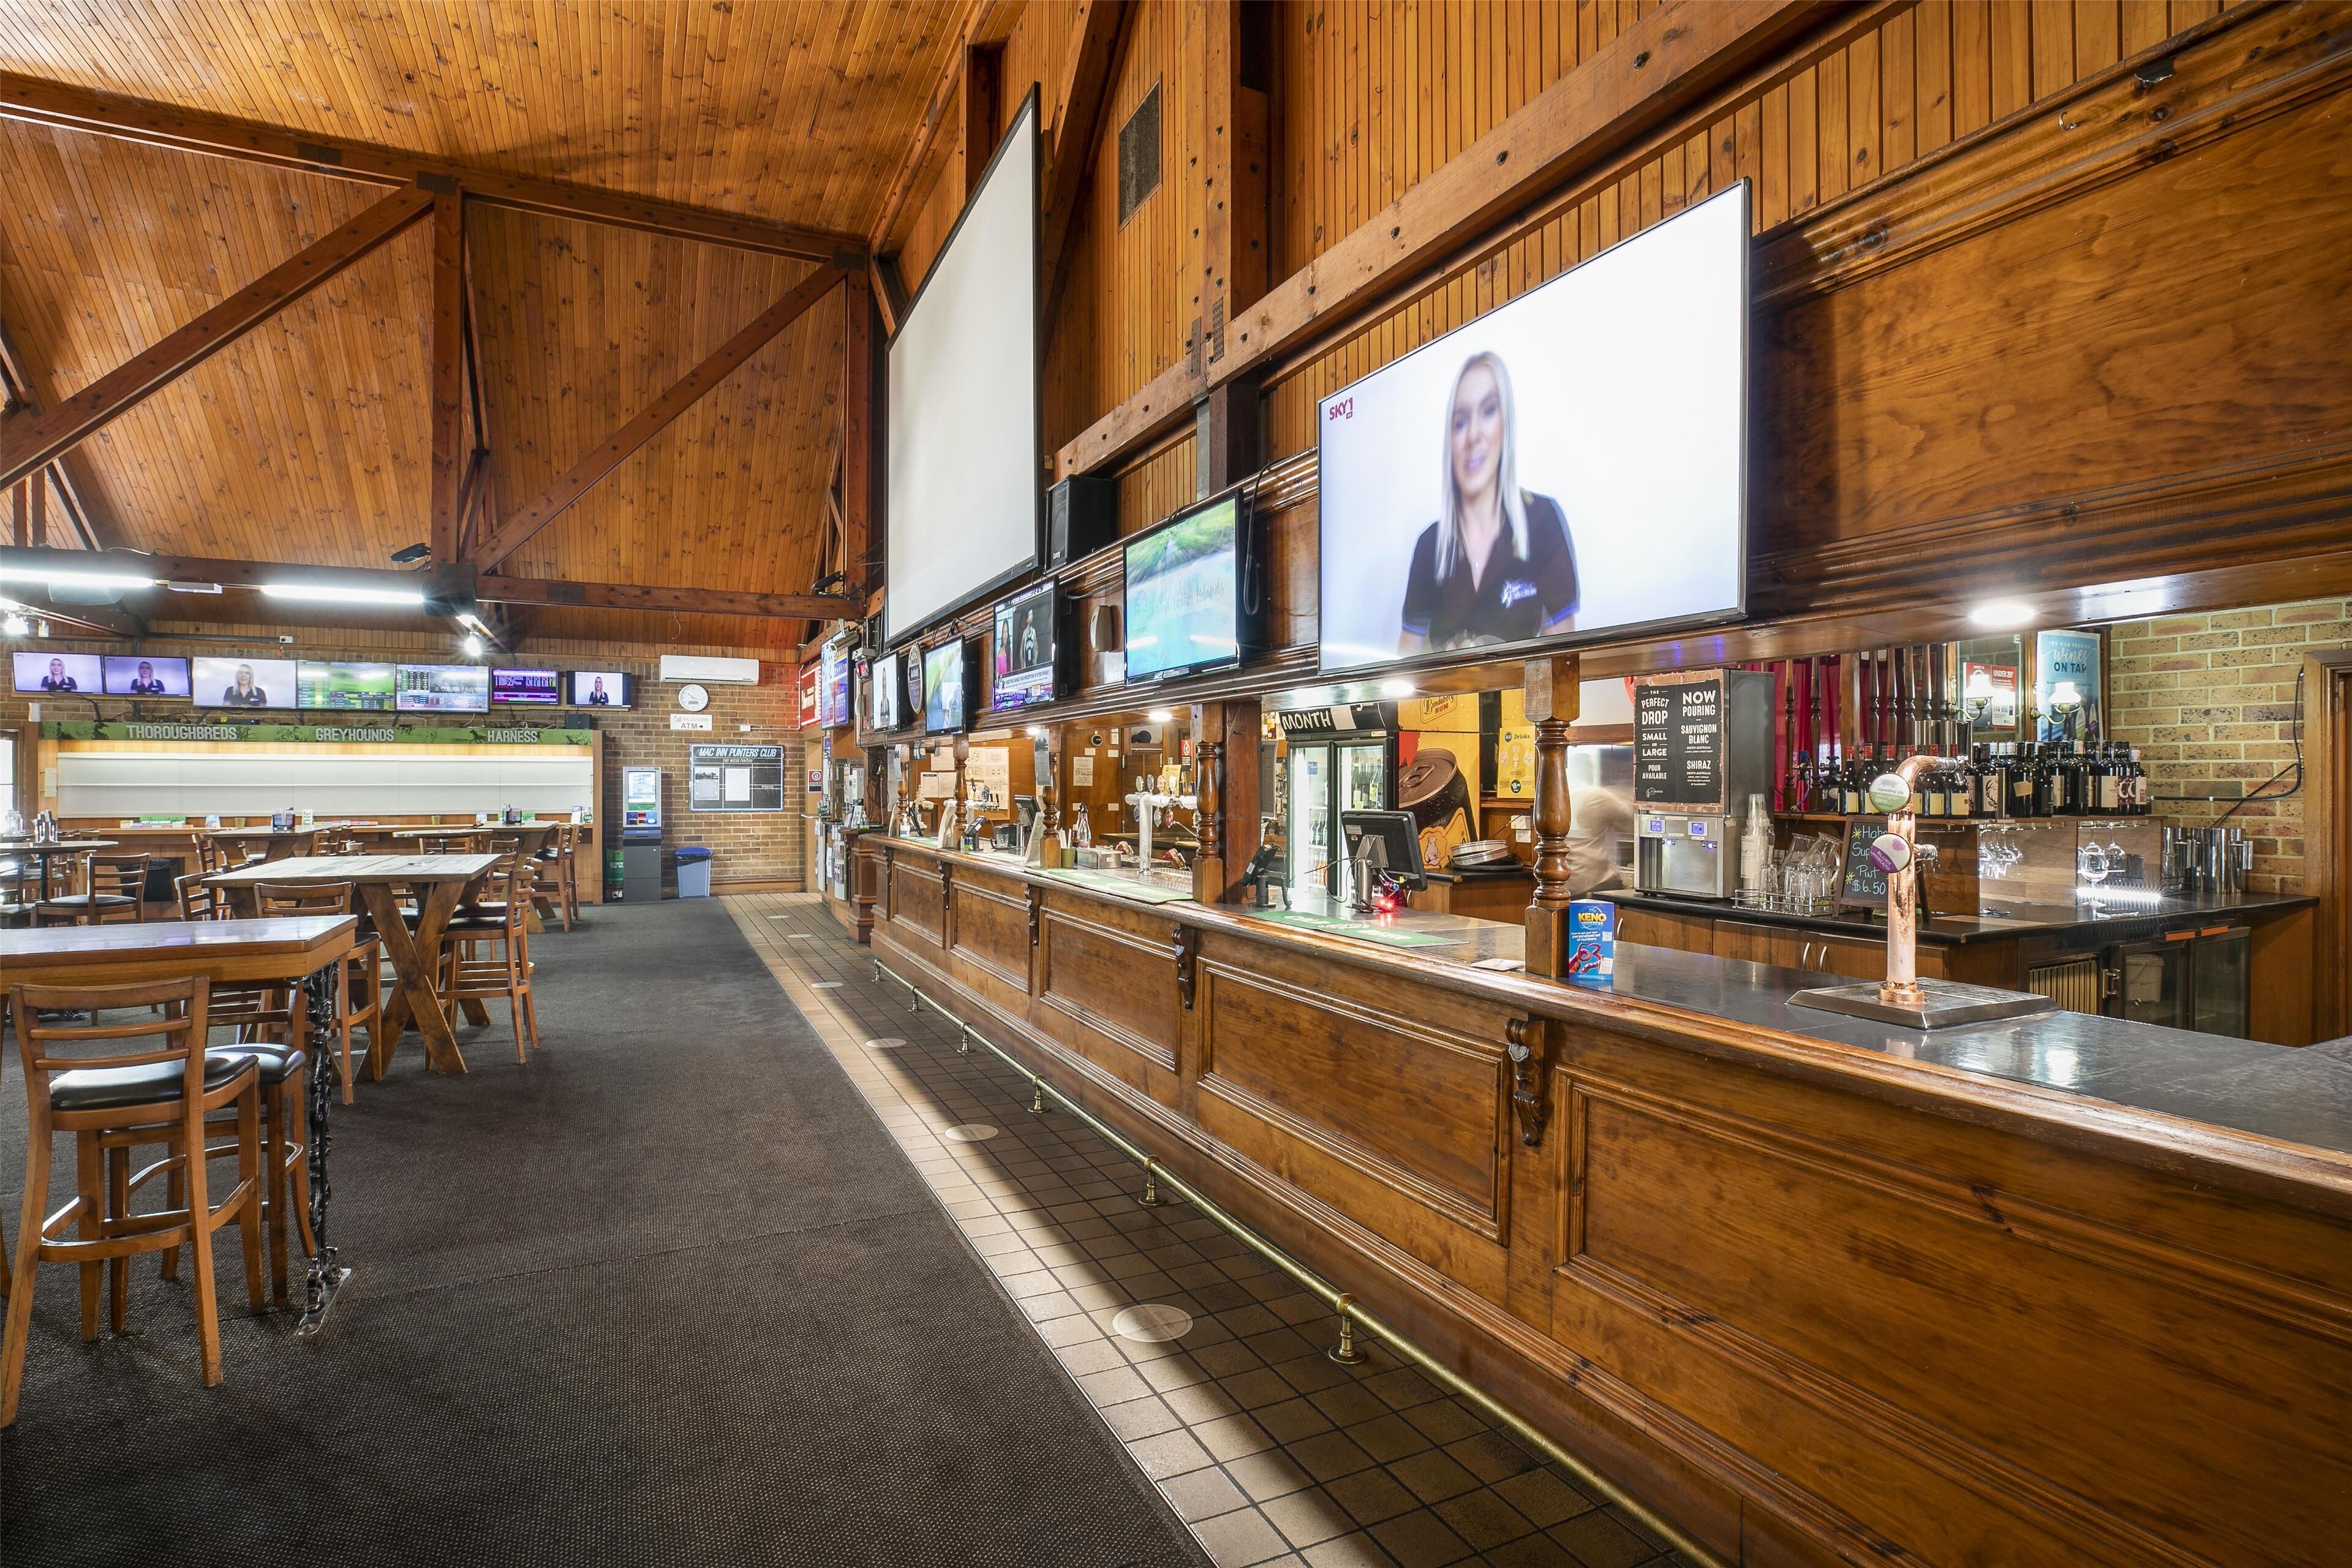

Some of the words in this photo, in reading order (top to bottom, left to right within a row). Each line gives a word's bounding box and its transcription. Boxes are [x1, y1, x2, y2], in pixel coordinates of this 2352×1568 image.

[1196, 578, 1225, 603] Islands
[2047, 647, 2091, 668] wines
[2054, 662, 2067, 673] ON
[2070, 663, 2087, 674] TAP
[1642, 698, 1669, 709] PERFECT
[1683, 690, 1716, 704] NOW
[1435, 703, 1449, 714] RUM
[1683, 704, 1716, 717] POURING
[1282, 710, 1332, 730] MONTH
[1642, 710, 1668, 725] DROP
[126, 725, 238, 740] THOROUGHBREDS
[315, 728, 394, 742] GREYHOUNDS
[488, 729, 538, 743] HARNESS
[1681, 724, 1717, 734] SAUVIGNON
[1642, 733, 1667, 741] SMALL
[1689, 734, 1709, 744] BLANC
[699, 747, 714, 756] MAC
[715, 748, 728, 756] INN
[729, 748, 759, 757] PUNTERS
[760, 748, 777, 757] CLUB
[1687, 760, 1711, 769] SHIRAZ
[1871, 852, 1891, 871] MOSCATO
[1877, 850, 1891, 866] BLUSH
[1852, 880, 1886, 895] $6.50
[1578, 912, 1607, 922] KENO
